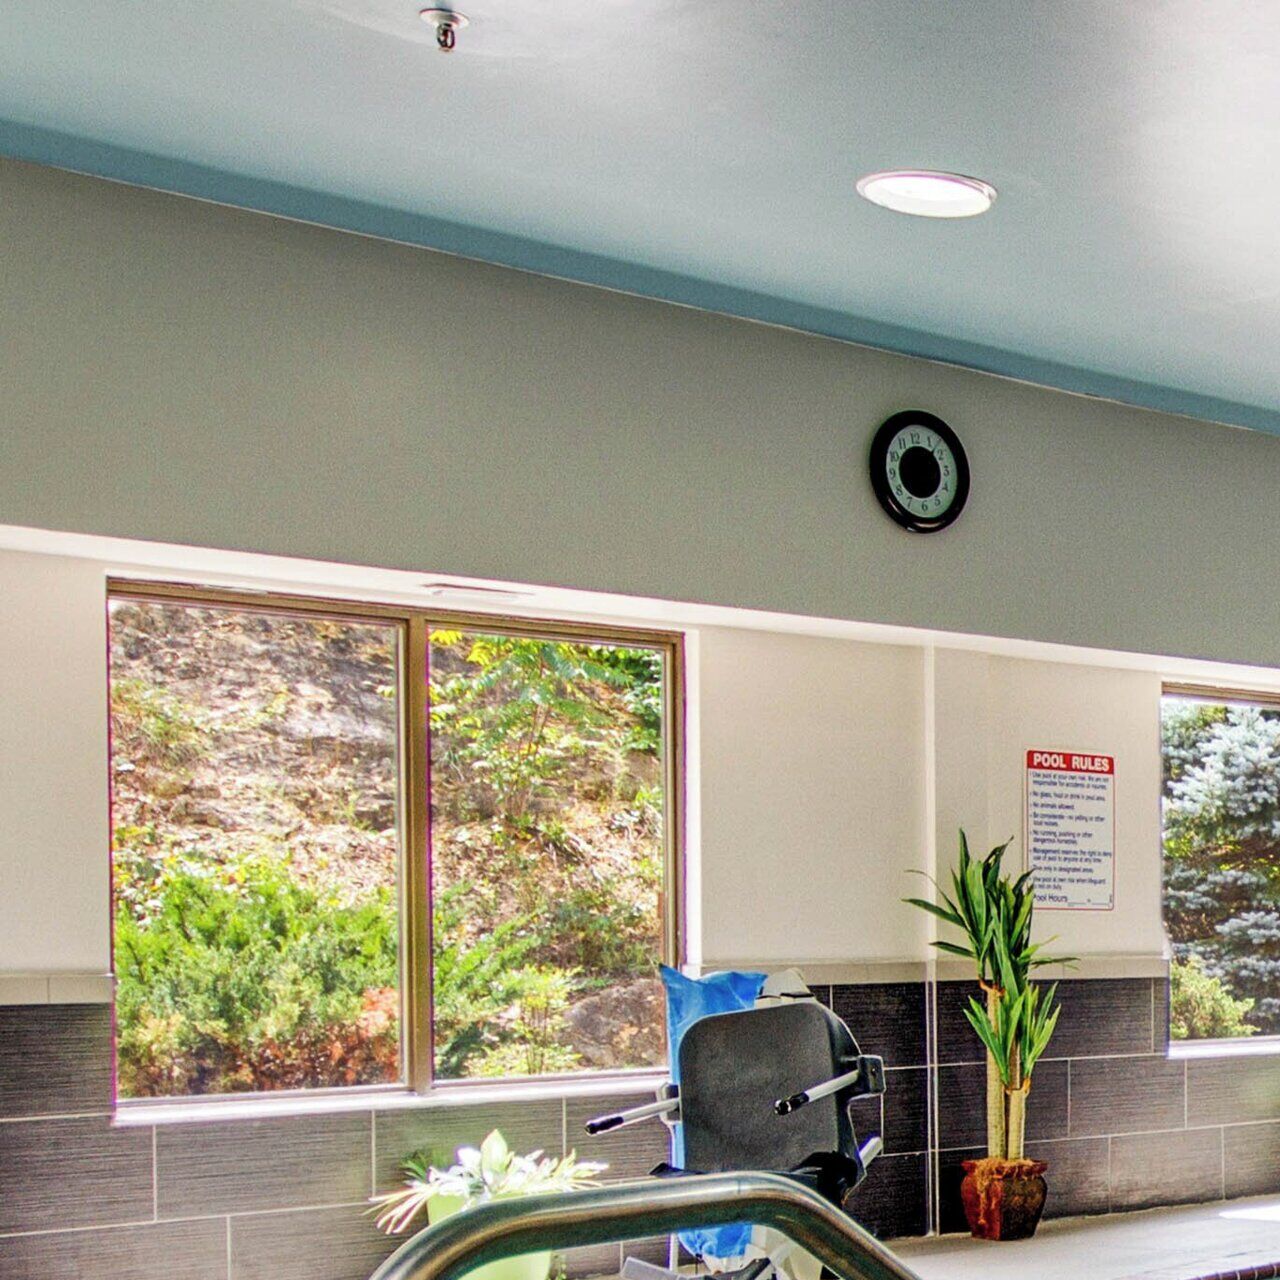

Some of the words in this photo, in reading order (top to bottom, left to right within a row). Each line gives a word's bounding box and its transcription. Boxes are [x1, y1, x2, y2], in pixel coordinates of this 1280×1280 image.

[911, 432, 920, 444] 12
[927, 436, 932, 446] 1
[898, 438, 906, 450] 11
[890, 451, 899, 462] 10
[937, 449, 944, 460] 2
[890, 468, 896, 480] 9
[944, 466, 950, 477] 3
[896, 484, 902, 496] 8
[942, 482, 948, 493] 4
[906, 497, 913, 508] 7
[922, 500, 928, 512] 6
[934, 496, 941, 506] 5
[1033, 753, 1066, 768] POOL
[1072, 756, 1110, 772] RULES
